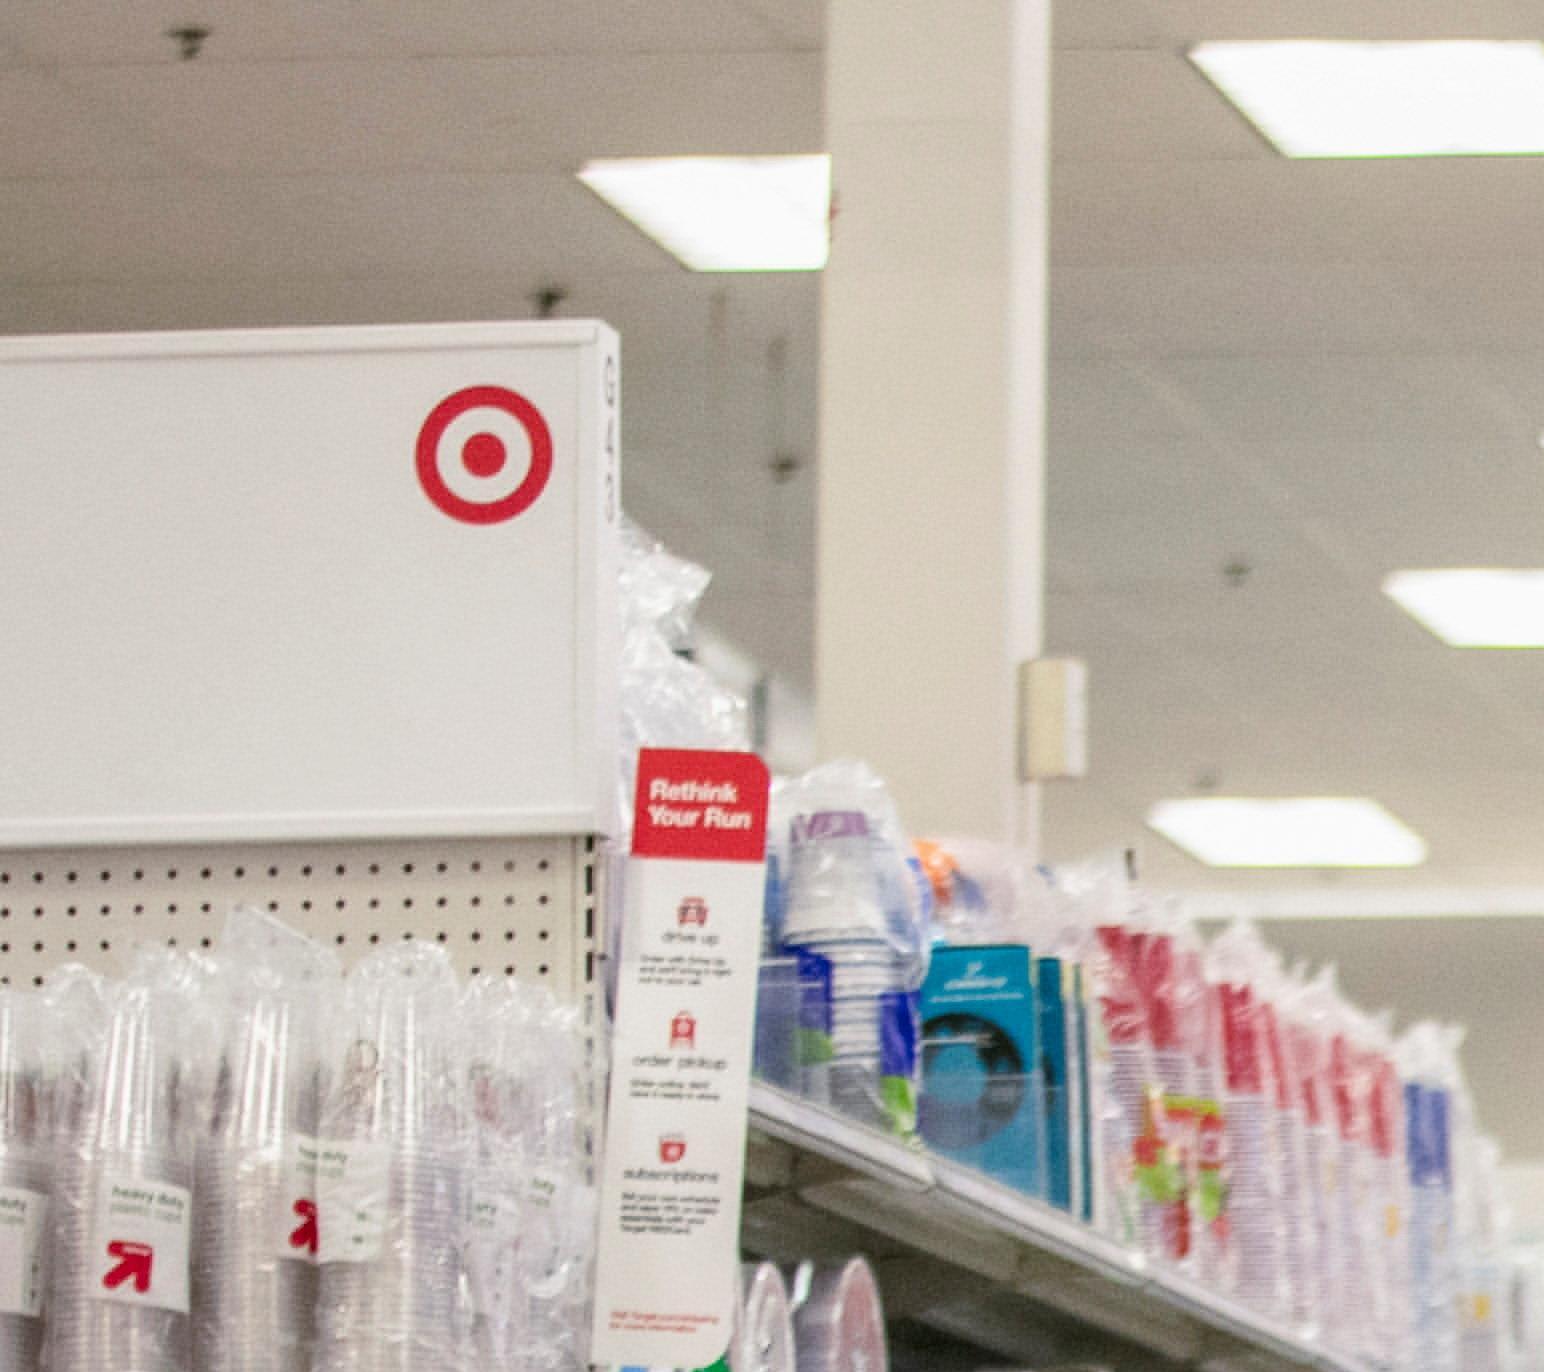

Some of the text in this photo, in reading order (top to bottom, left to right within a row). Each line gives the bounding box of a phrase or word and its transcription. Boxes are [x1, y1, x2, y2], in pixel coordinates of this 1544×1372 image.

[648, 779, 738, 804] Rethink
[648, 806, 752, 830] Your Run
